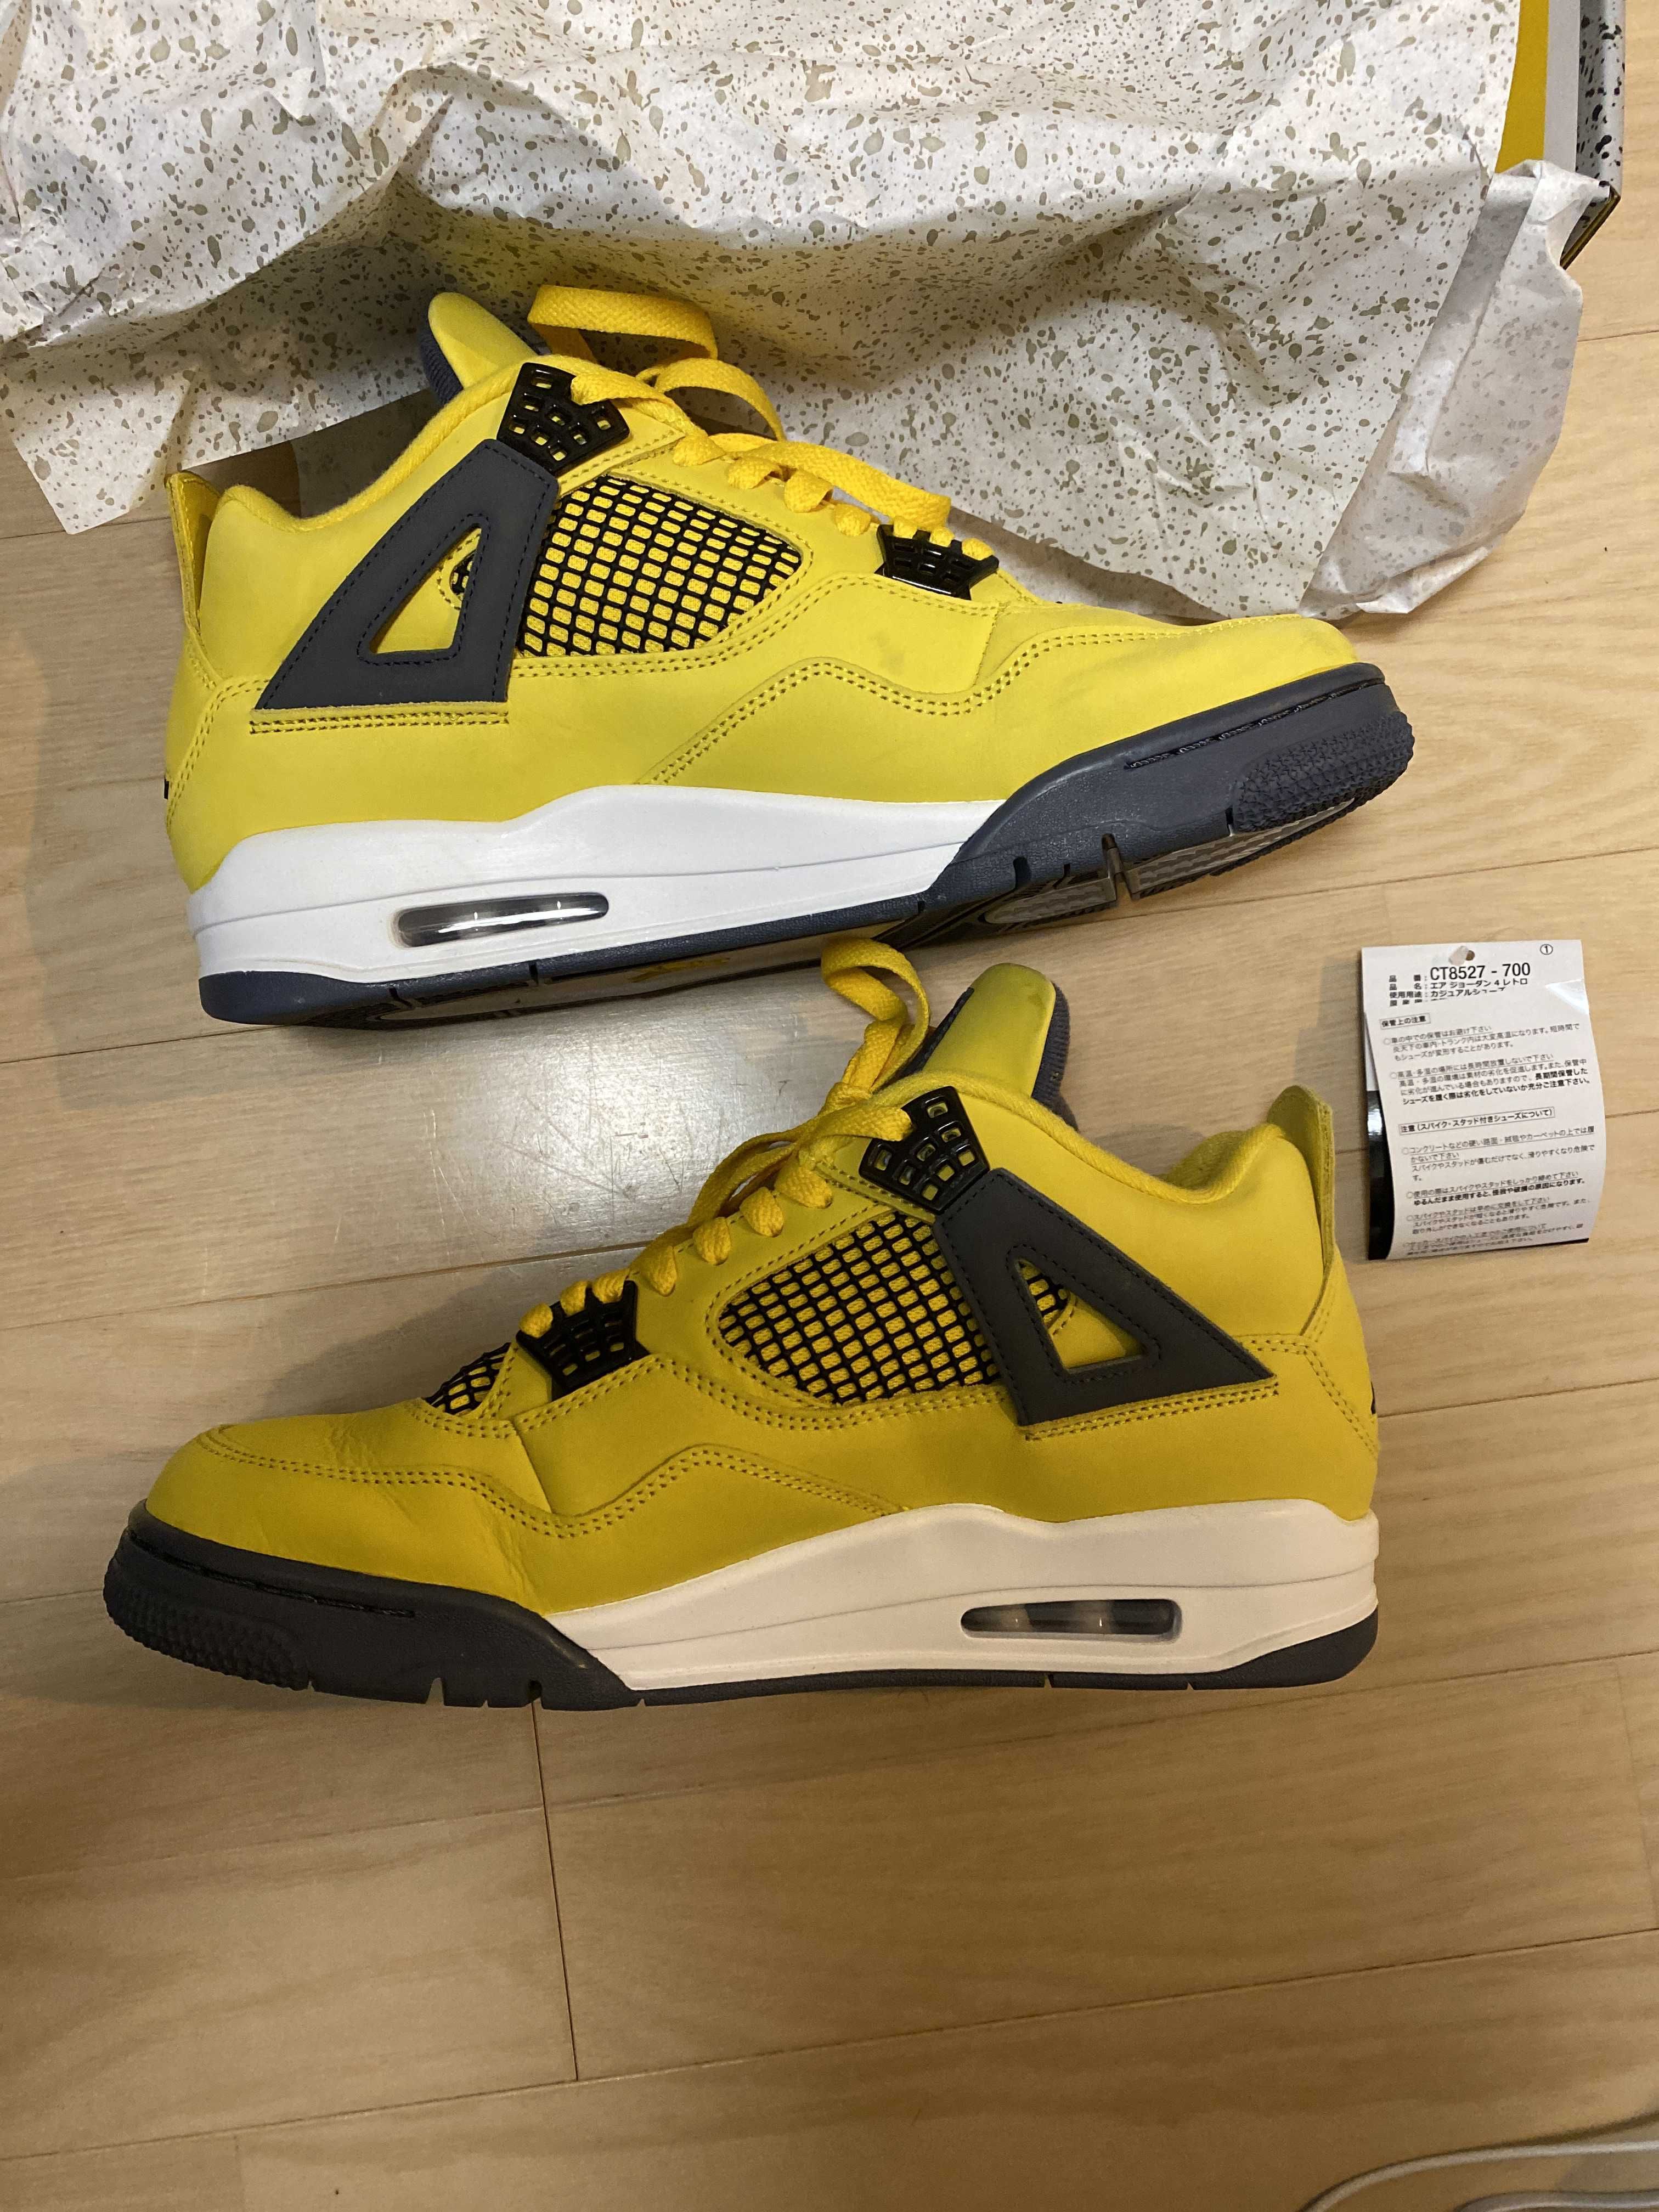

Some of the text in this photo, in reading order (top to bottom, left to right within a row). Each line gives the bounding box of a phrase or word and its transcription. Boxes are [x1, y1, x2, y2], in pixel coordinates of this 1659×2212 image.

[1430, 965, 1486, 980] CT8527
[1502, 962, 1531, 977] 700
[1430, 981, 1447, 989] エア
[1449, 980, 1492, 989] ジョーダン
[1503, 978, 1528, 986] レトロ
[1381, 1015, 1427, 1028] 保管上の注意
